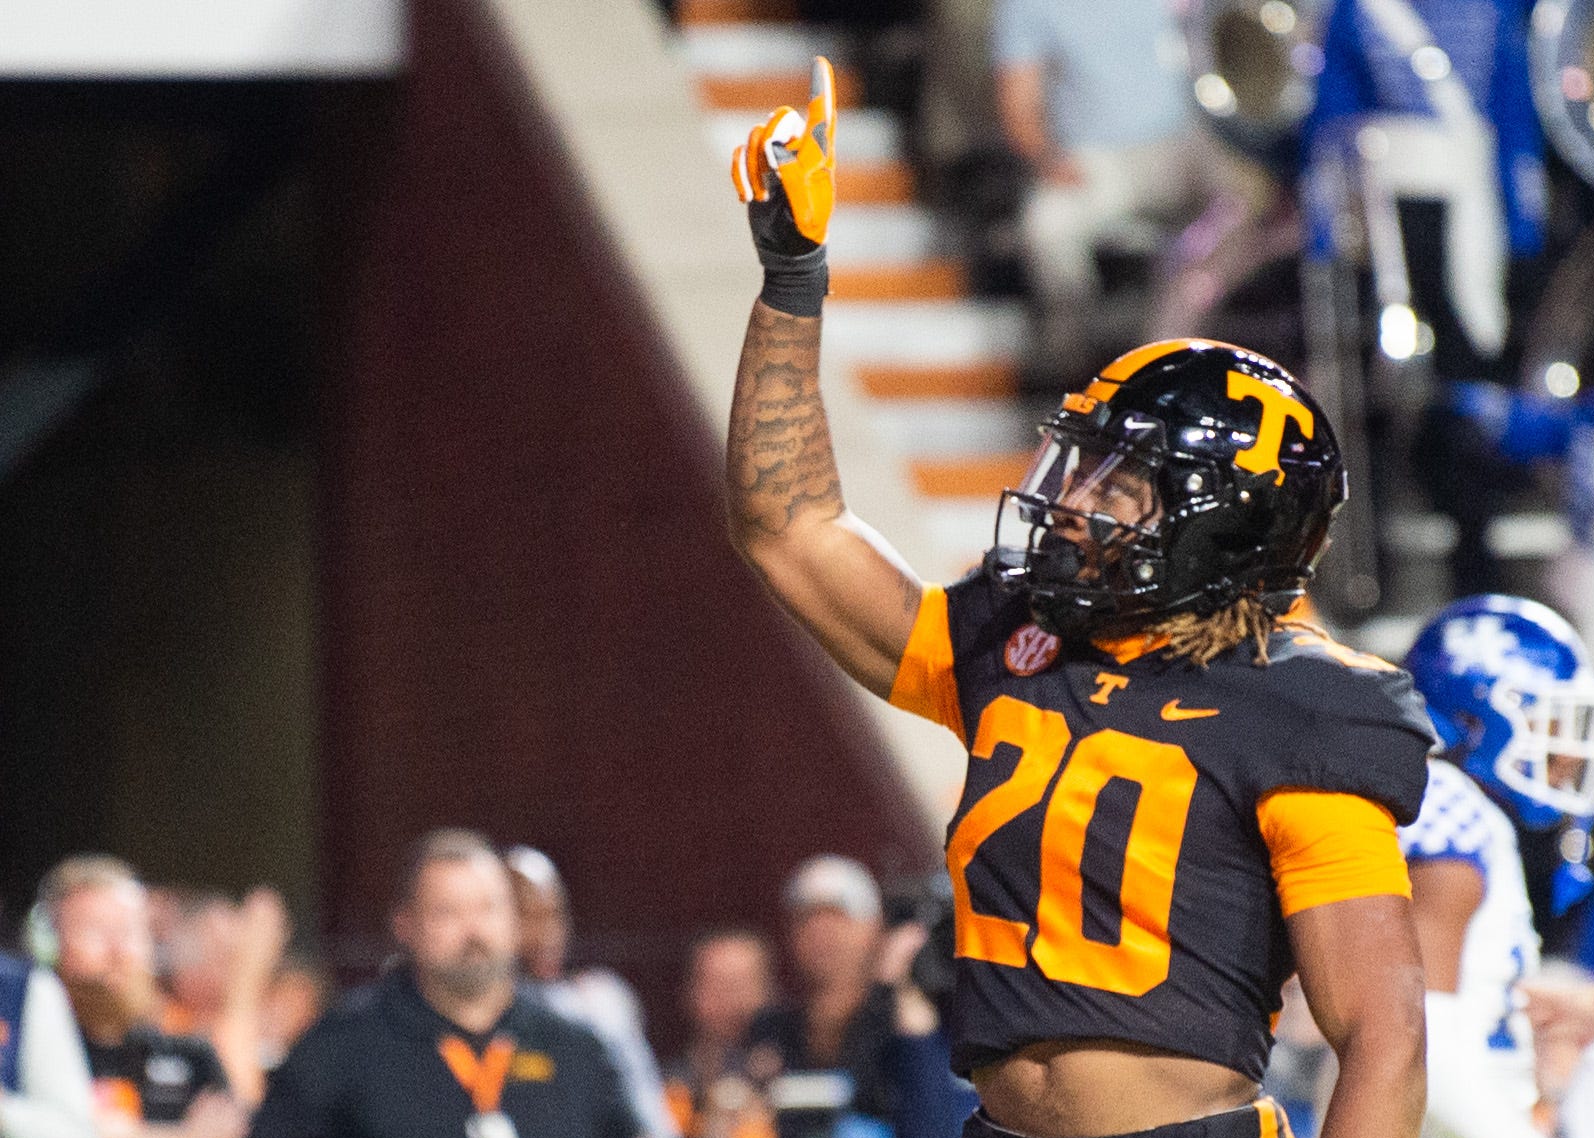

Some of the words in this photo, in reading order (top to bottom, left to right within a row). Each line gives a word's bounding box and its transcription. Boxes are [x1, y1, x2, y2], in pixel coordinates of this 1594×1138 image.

[1226, 370, 1314, 487] T
[1088, 671, 1130, 705] T
[945, 693, 1198, 998] 20
